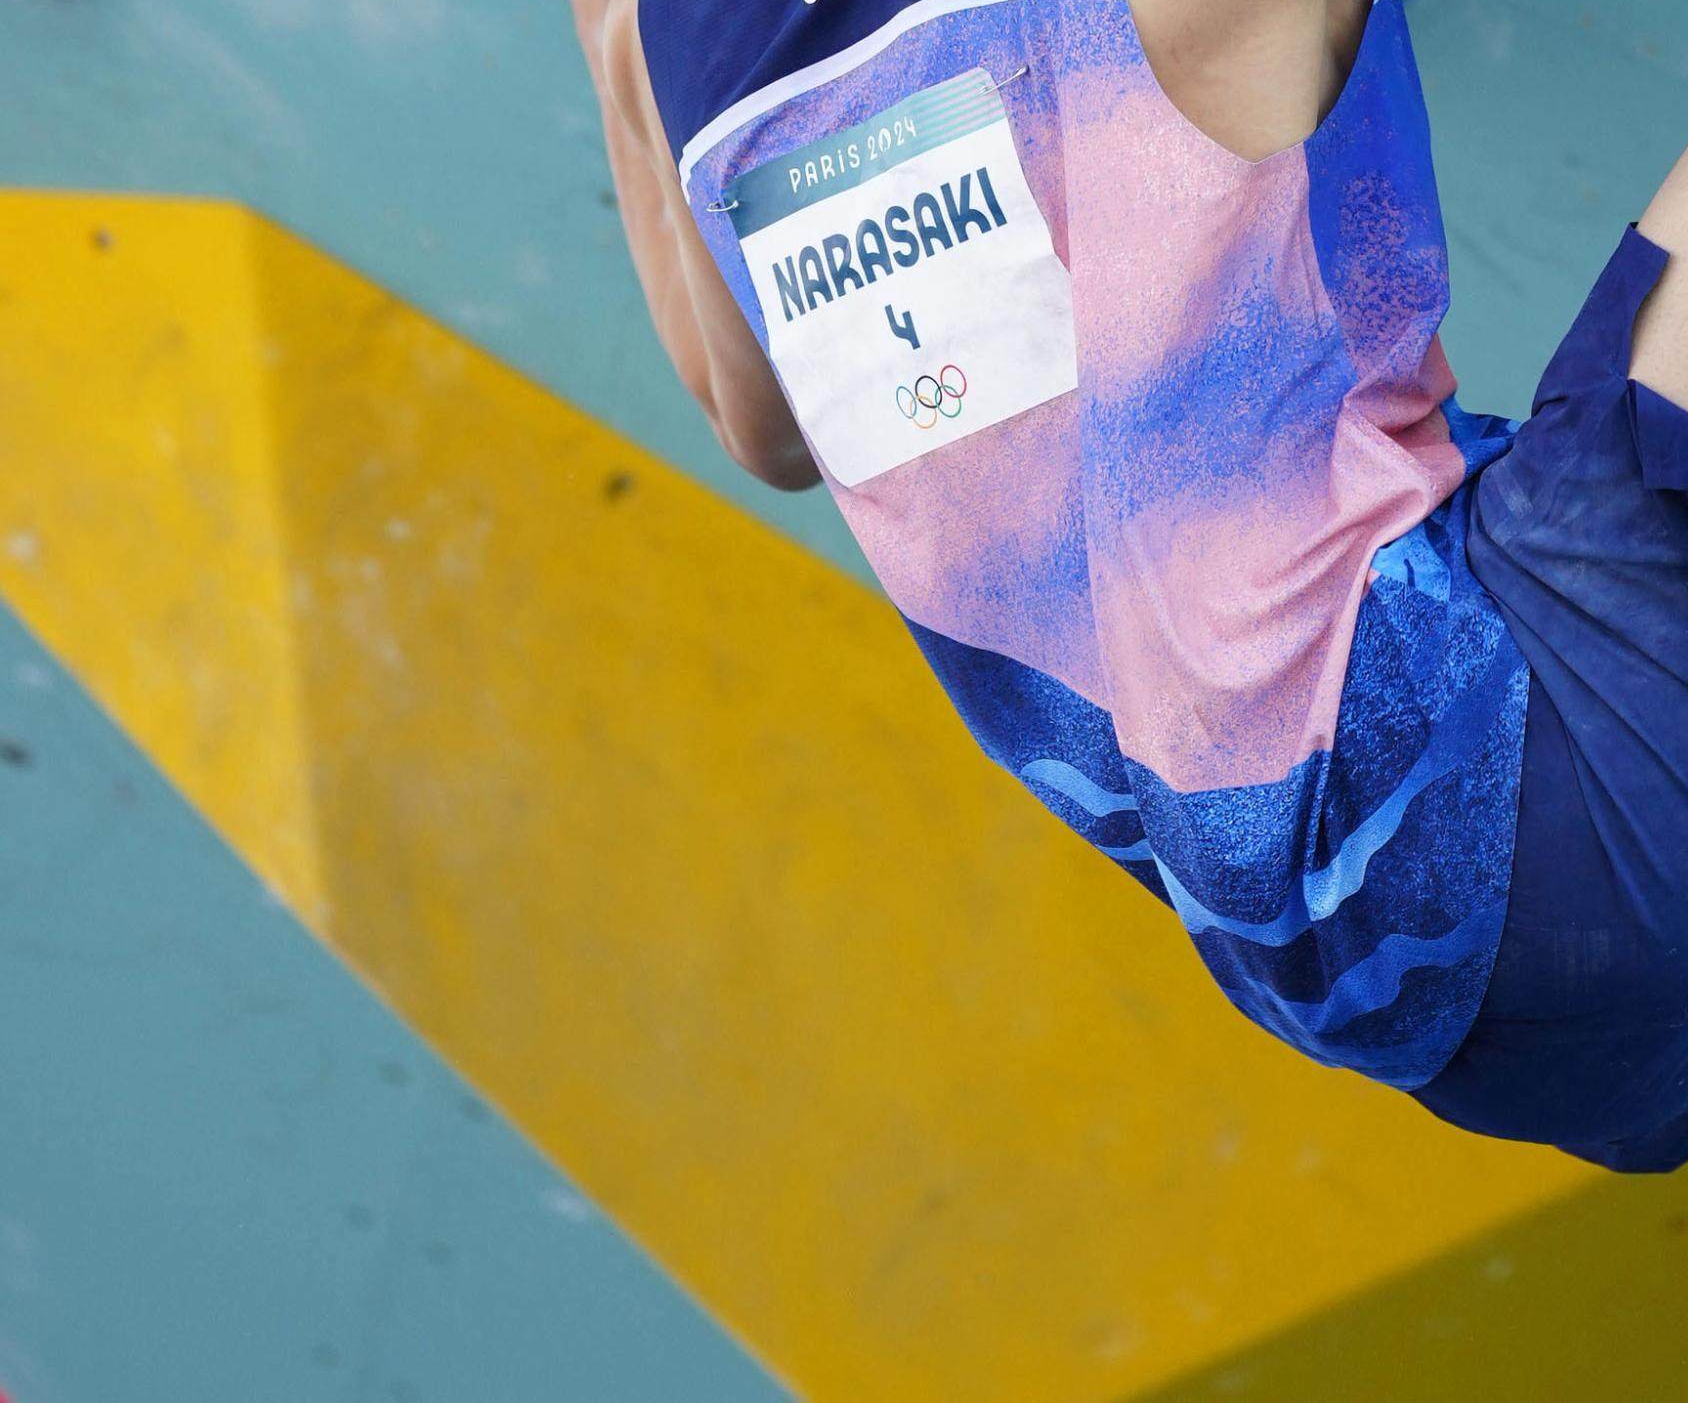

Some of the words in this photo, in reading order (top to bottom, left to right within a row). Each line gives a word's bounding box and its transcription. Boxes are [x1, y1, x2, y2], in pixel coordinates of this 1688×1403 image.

[867, 116, 917, 161] 2024
[772, 166, 1007, 323] NARASAKI
[885, 304, 921, 350] 4
